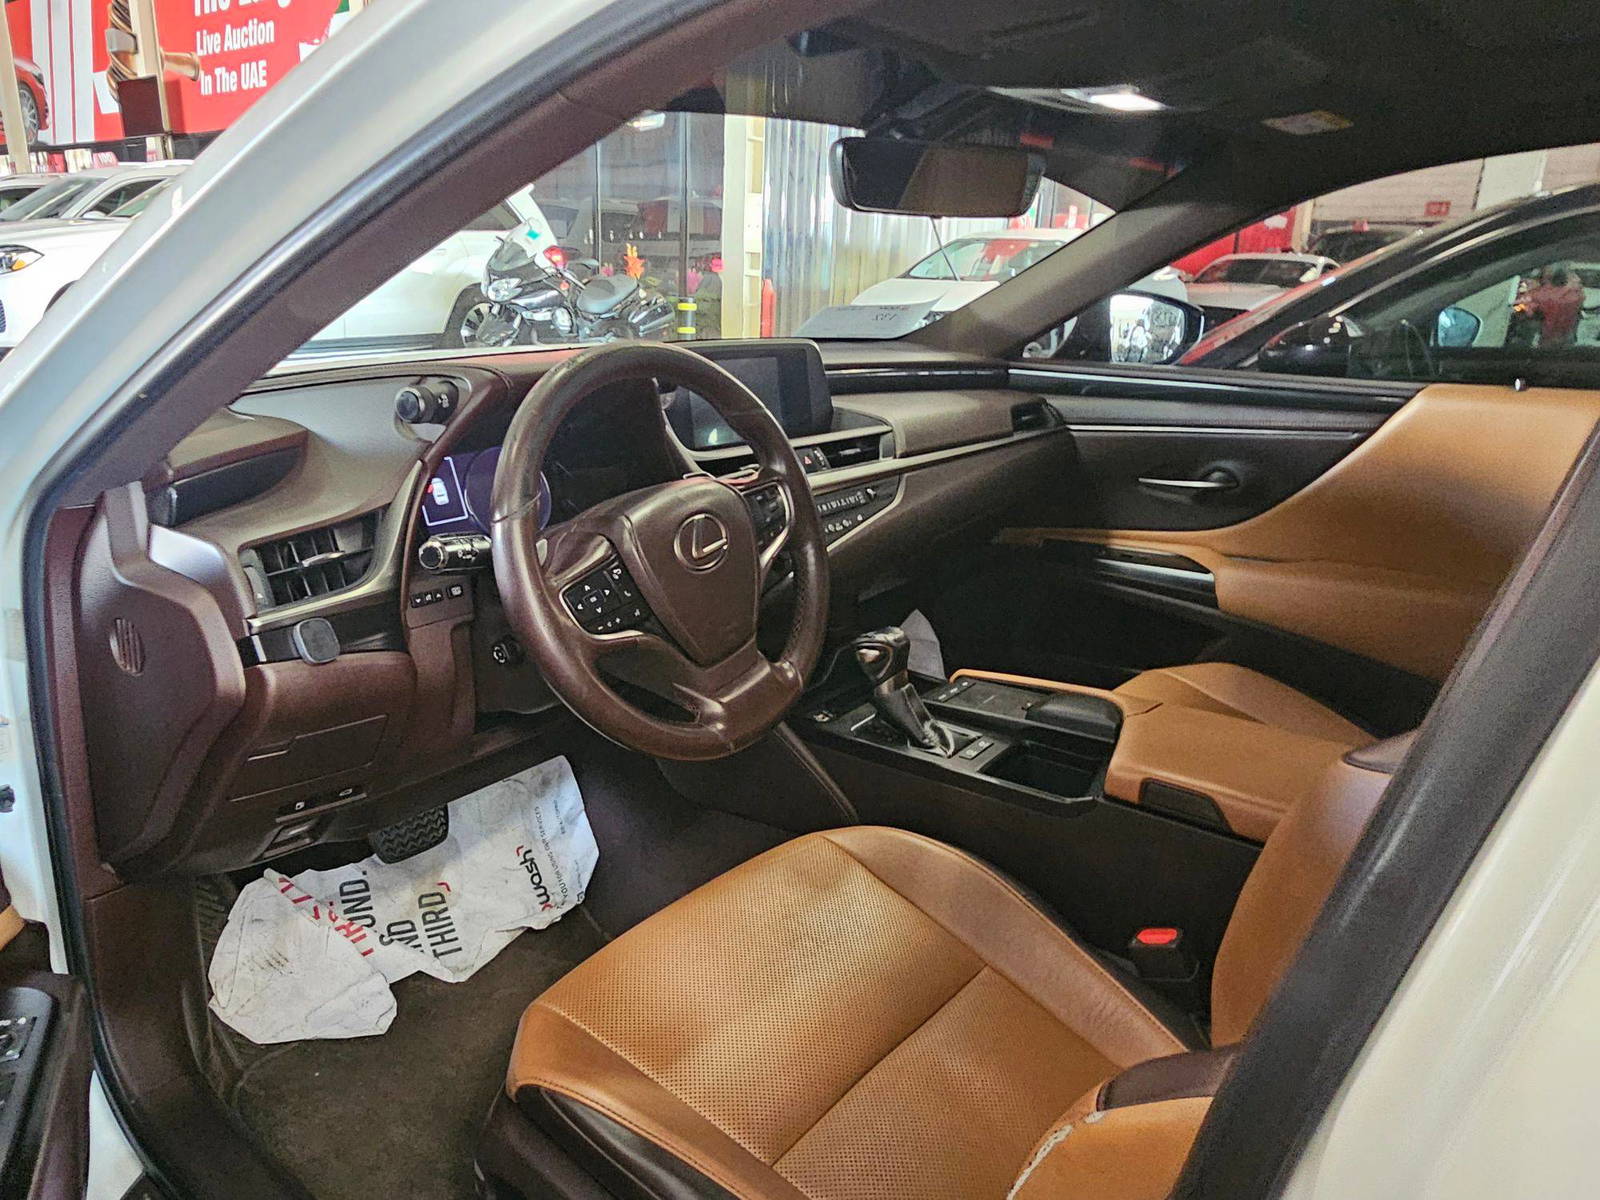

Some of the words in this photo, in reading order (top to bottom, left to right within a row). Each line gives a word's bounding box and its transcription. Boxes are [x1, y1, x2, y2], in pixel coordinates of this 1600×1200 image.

[196, 29, 221, 56] Live
[223, 18, 275, 51] Auction
[200, 70, 213, 96] In
[214, 67, 238, 94] The
[240, 60, 267, 91] UAE
[417, 891, 463, 960] THIRD
